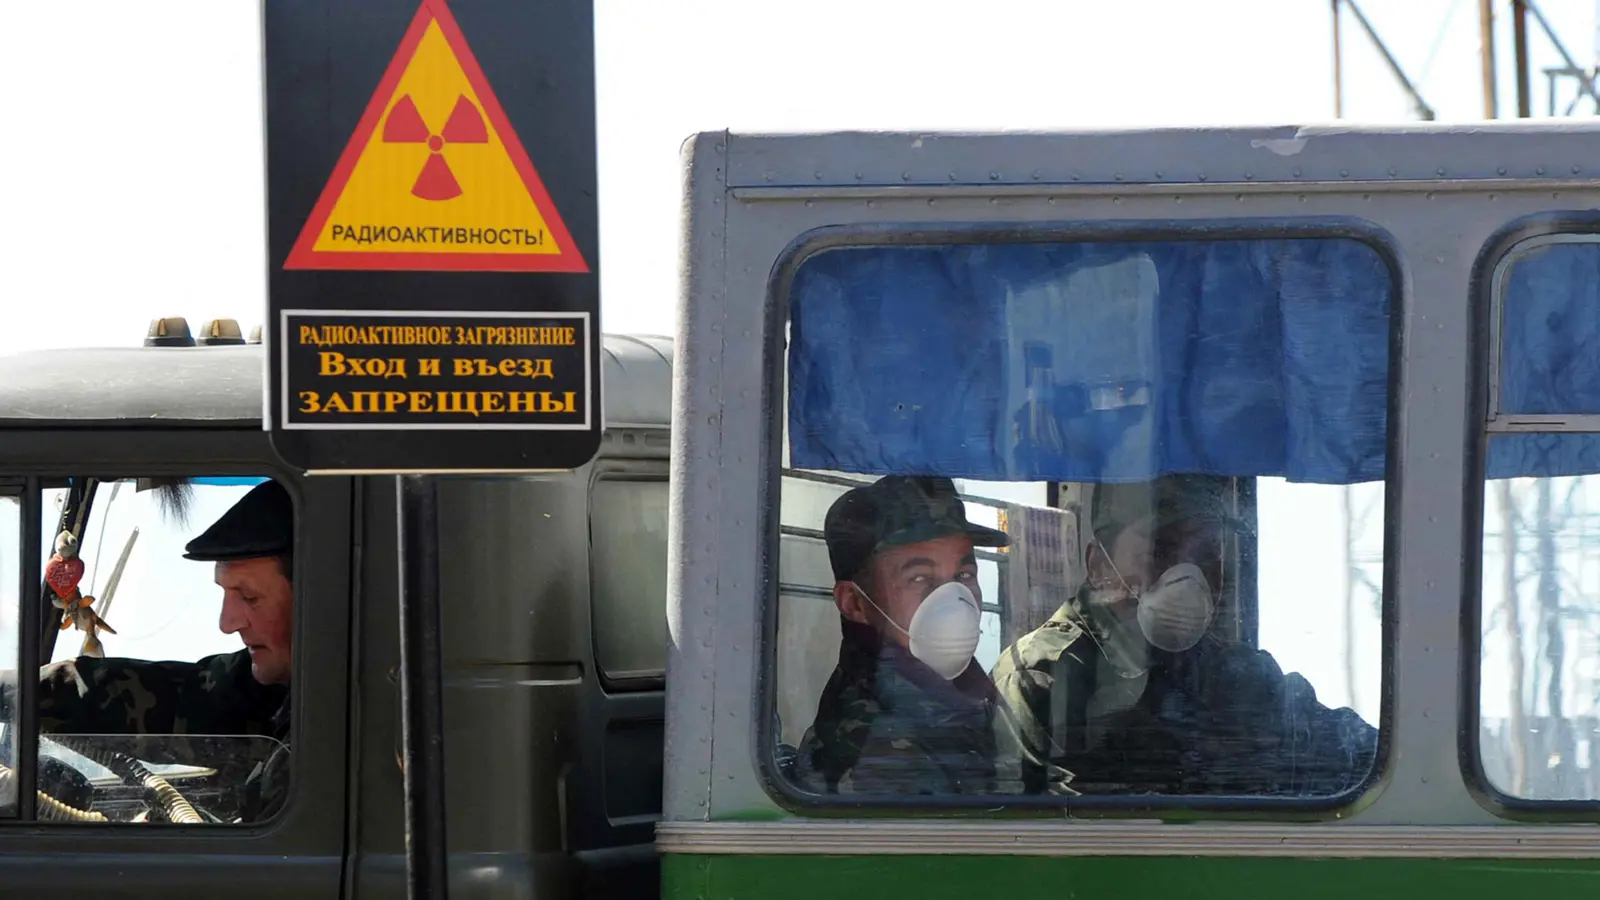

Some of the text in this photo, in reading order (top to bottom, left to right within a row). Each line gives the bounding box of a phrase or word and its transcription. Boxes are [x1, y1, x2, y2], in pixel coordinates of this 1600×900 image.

[332, 224, 543, 246] РАДИОАКТИВНОСТЬ!
[300, 325, 576, 347] РАДИОАКТИВНОЕ ЗАГРЯЗНЕНИЕ
[319, 352, 554, 379] Вход и въезд
[299, 391, 577, 417] ЗАПРЕЩЕНЫ
